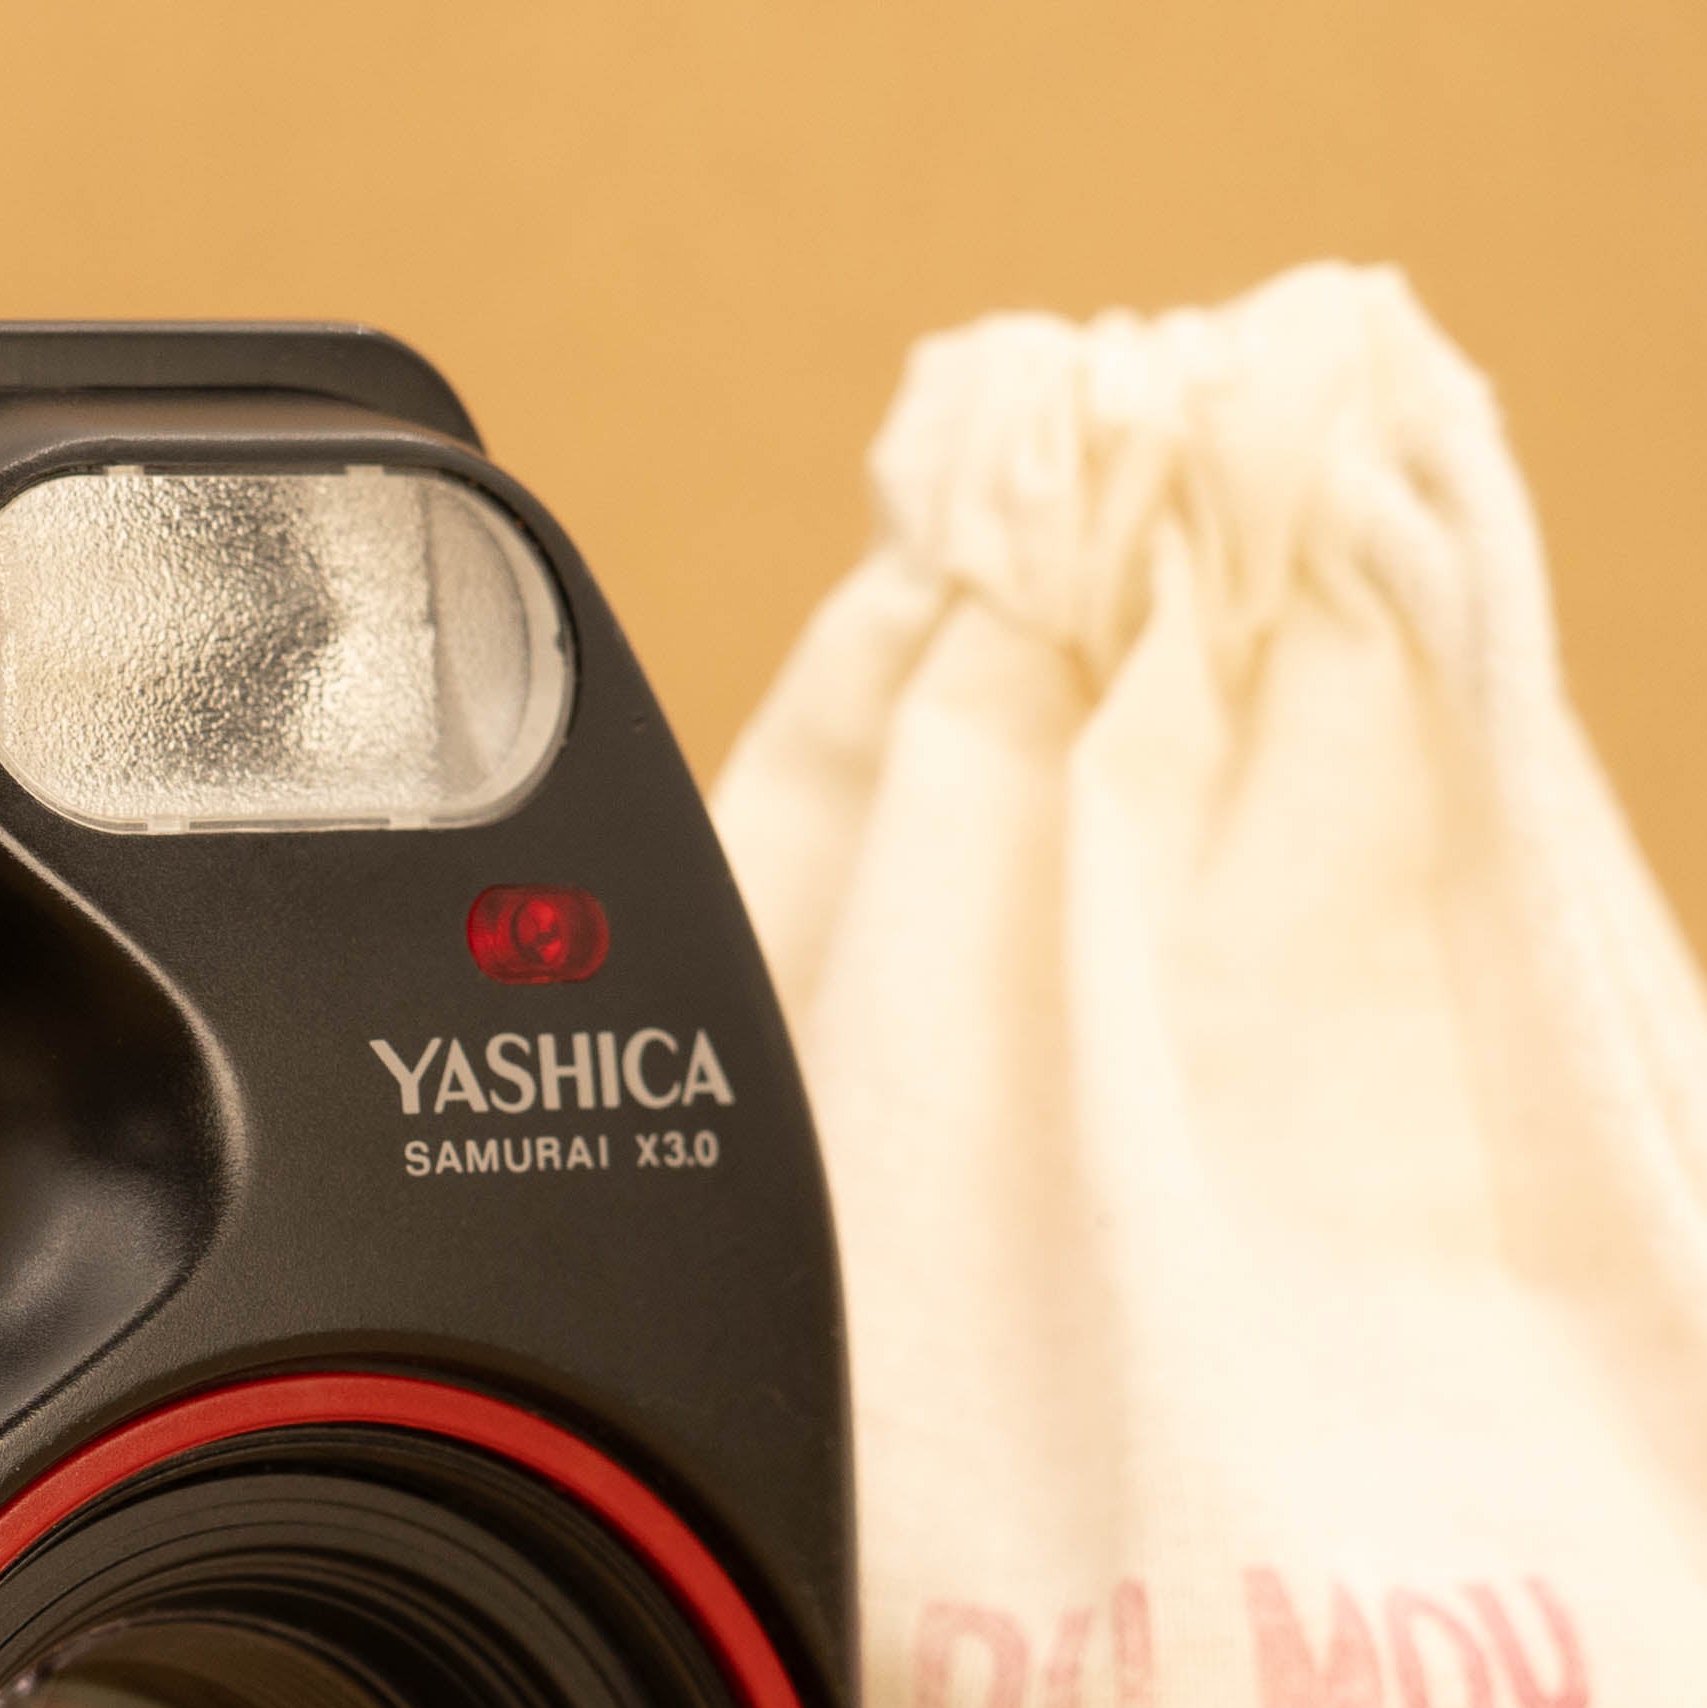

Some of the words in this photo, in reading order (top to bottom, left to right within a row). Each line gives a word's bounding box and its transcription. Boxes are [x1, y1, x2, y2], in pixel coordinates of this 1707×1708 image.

[368, 1028, 736, 1115] YASHICA
[403, 1134, 611, 1177] SAMURAI
[635, 1130, 720, 1169] X3.0
